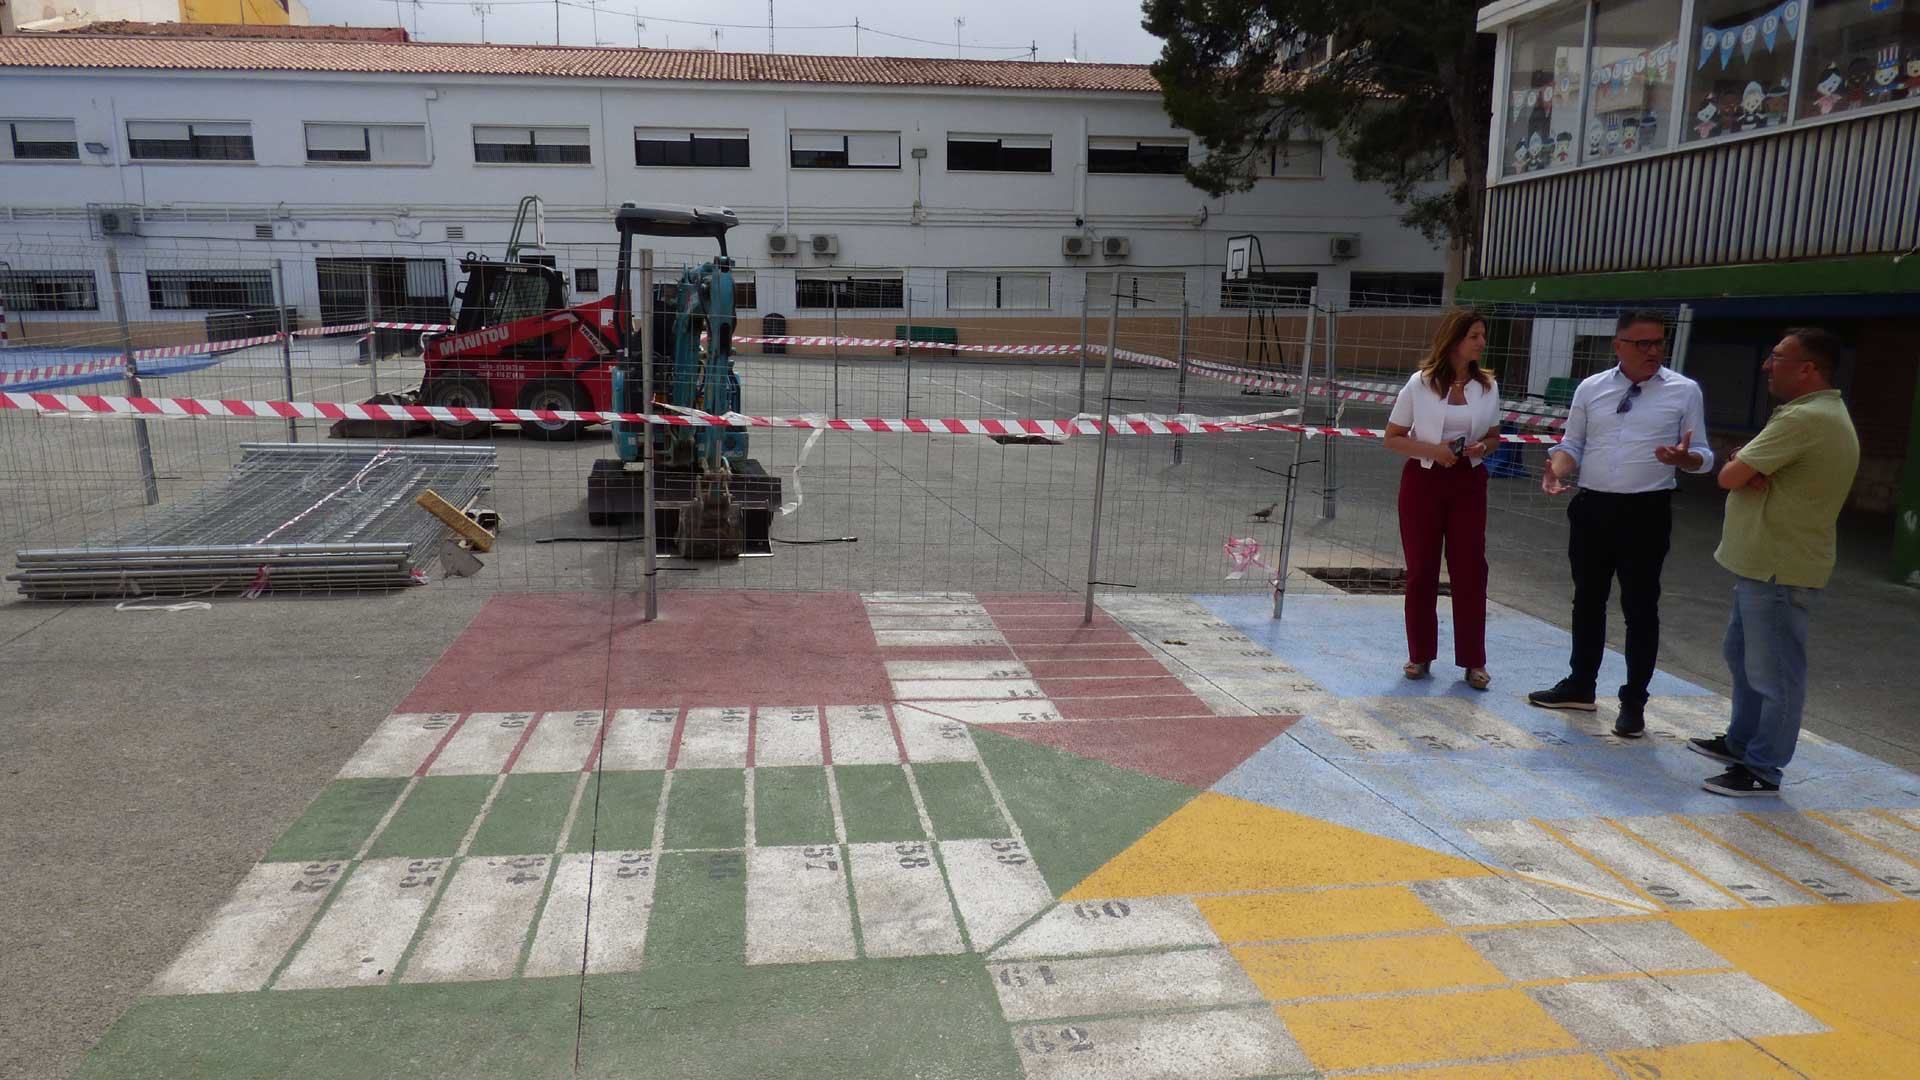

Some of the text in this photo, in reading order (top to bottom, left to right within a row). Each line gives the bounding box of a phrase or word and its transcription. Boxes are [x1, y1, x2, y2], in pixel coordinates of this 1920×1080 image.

[440, 326, 509, 355] MANITOU
[1018, 713, 1057, 721] 42
[804, 847, 838, 871] 57
[895, 844, 930, 869] 58
[991, 841, 1027, 865] 59
[400, 860, 443, 888] 53
[506, 858, 546, 884] 54
[617, 852, 652, 879] 55
[1646, 884, 1697, 905] 10
[1074, 900, 1131, 920] 60
[1000, 966, 1058, 988] 61
[1023, 1027, 1094, 1053] 62
